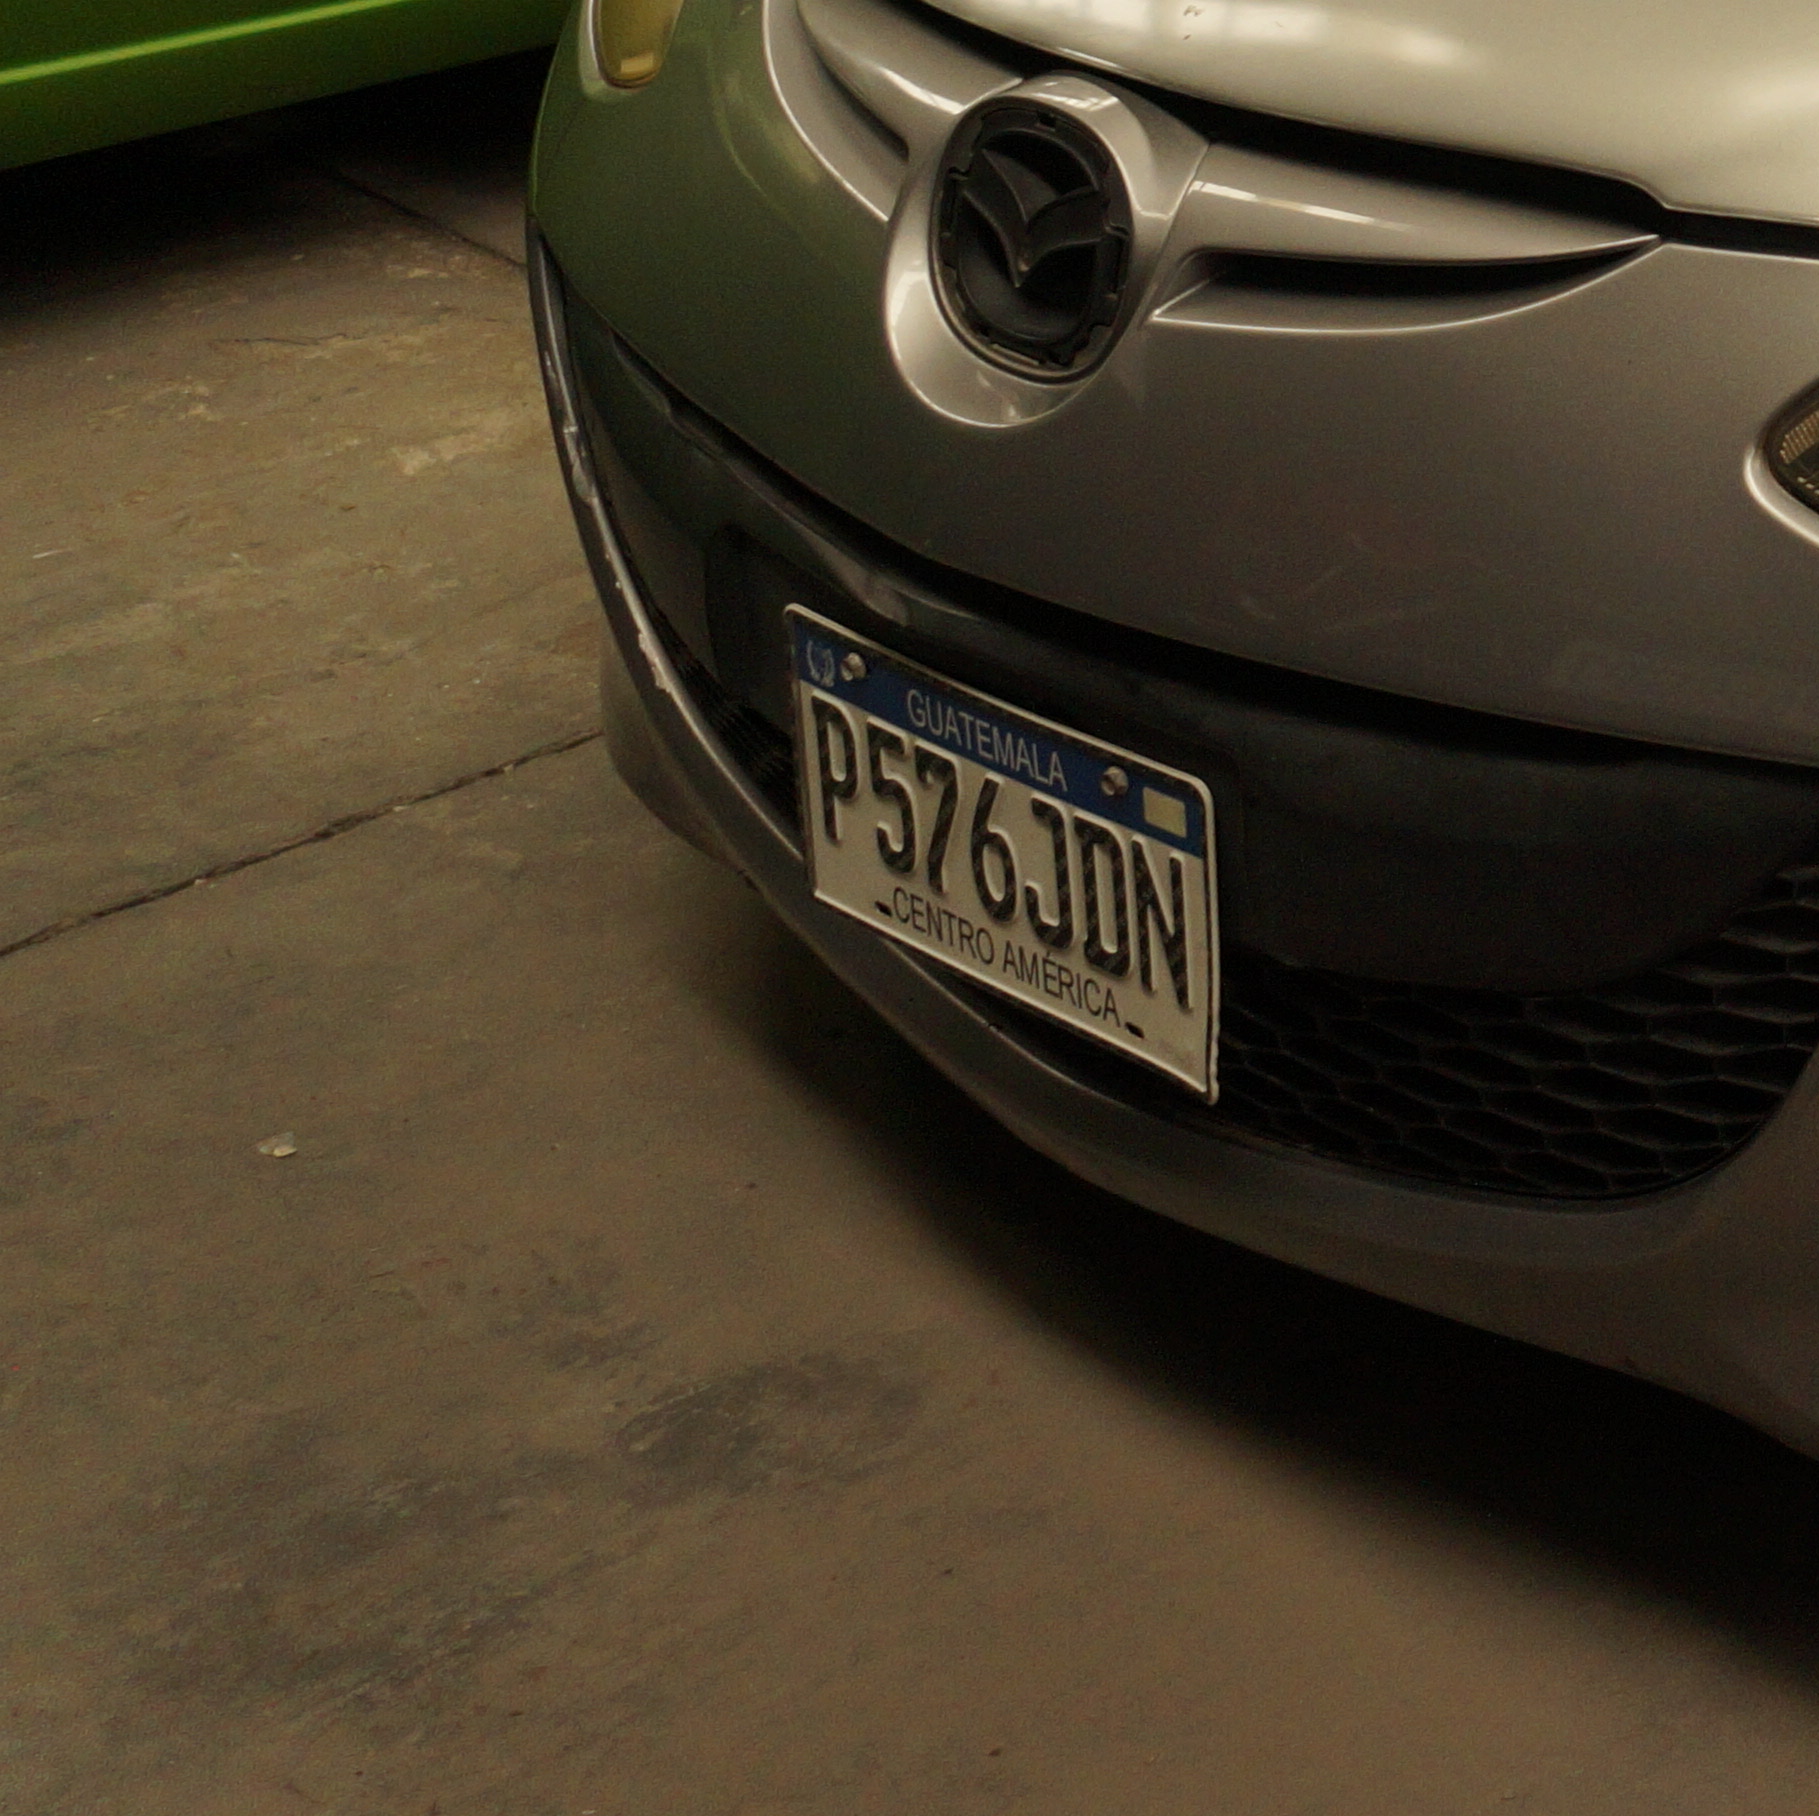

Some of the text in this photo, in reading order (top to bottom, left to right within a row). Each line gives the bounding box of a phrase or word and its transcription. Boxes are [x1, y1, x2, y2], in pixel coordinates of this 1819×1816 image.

[907, 690, 1067, 791] GUATEMALA
[811, 692, 1195, 1013] P576JDN
[892, 887, 1120, 1024] CENTRO AMÉRICA
